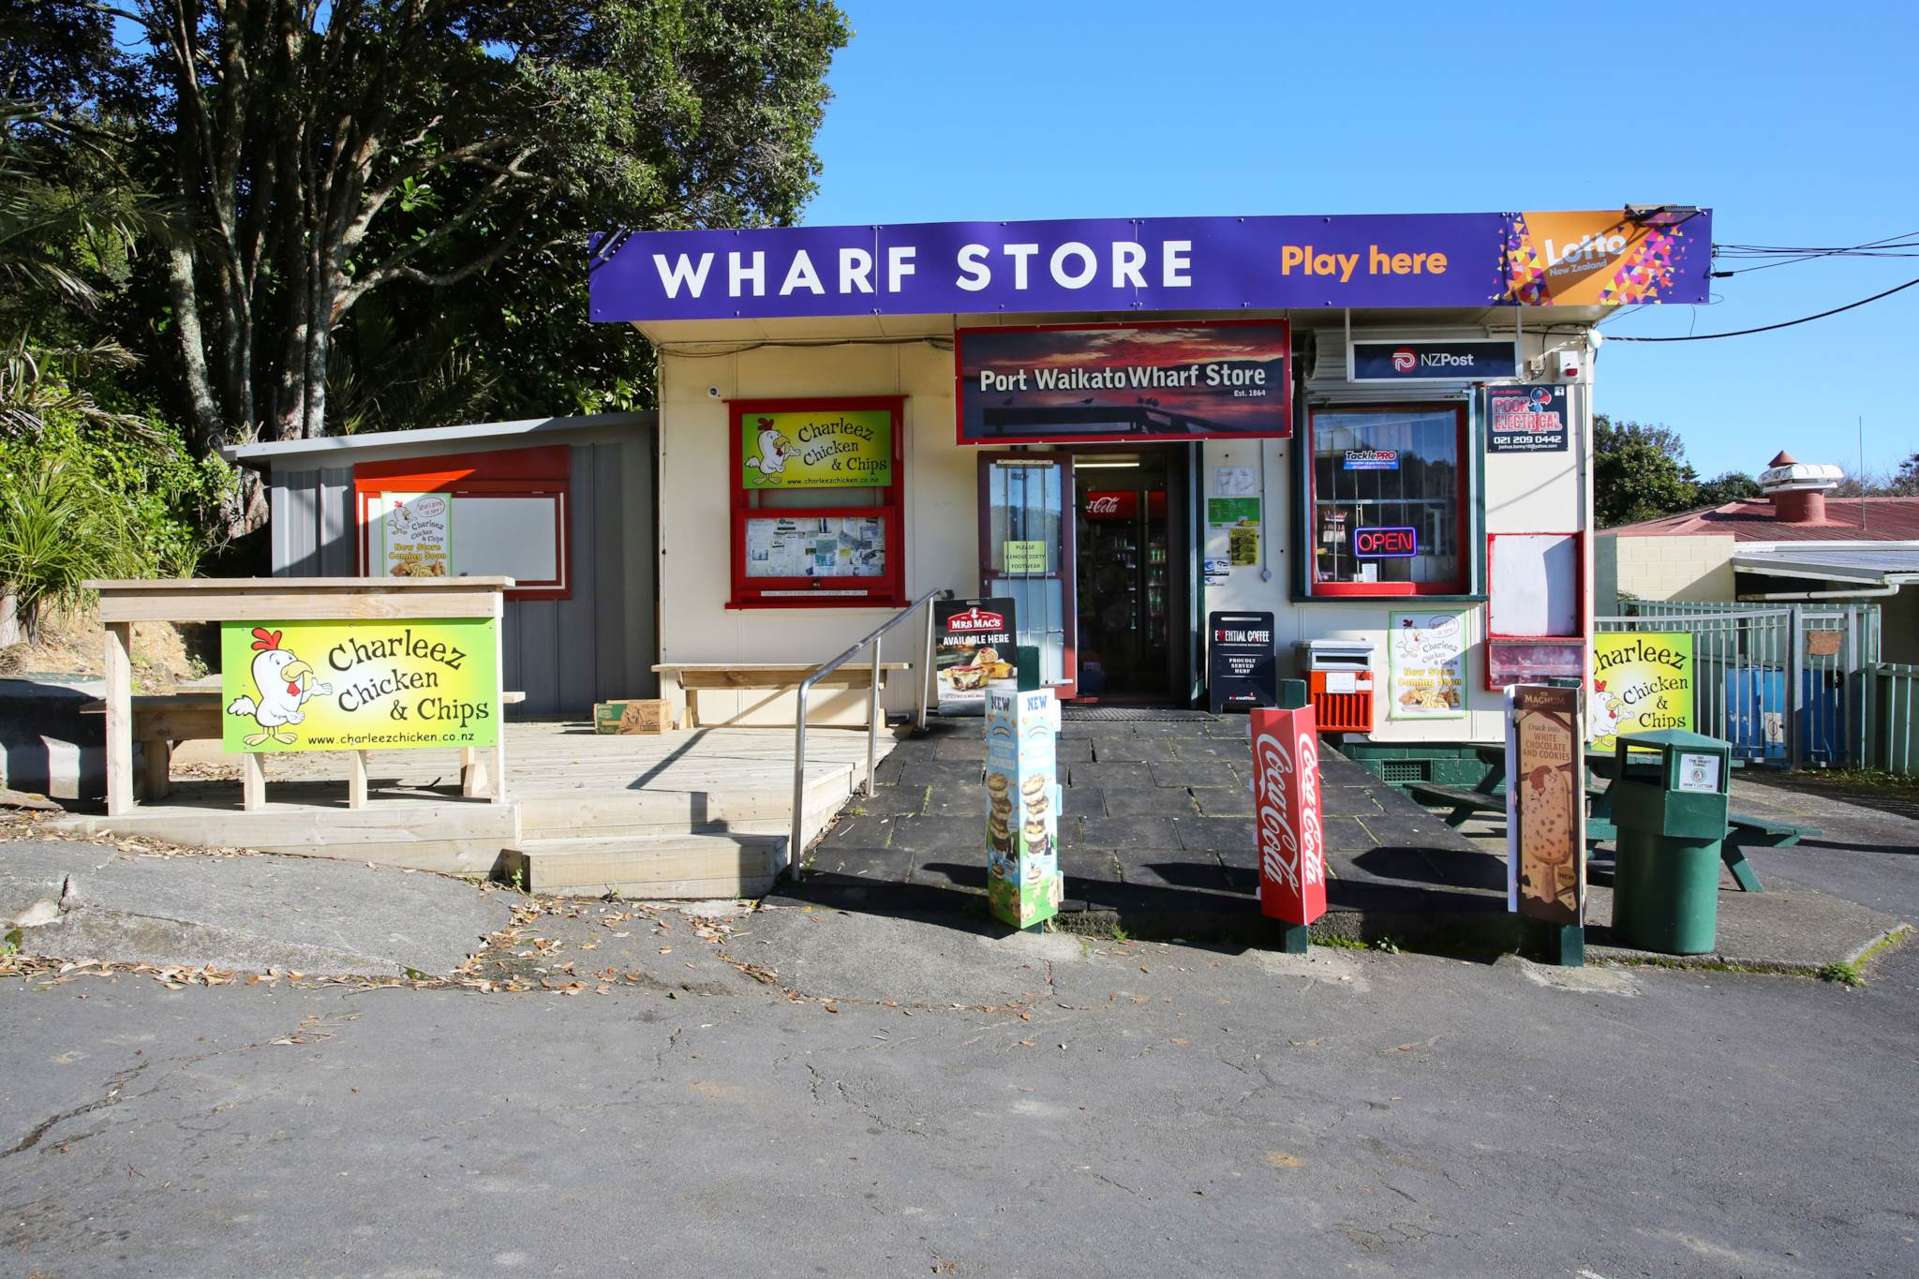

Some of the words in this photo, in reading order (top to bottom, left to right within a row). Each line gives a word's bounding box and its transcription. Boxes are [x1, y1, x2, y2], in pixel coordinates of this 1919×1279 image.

[1544, 232, 1627, 267] Lotto
[653, 246, 916, 299] WHARF
[956, 240, 1192, 292] STORE
[1281, 245, 1359, 283] Play
[1369, 244, 1448, 275] here
[1550, 267, 1570, 277] New
[1570, 259, 1608, 273] Zealand
[1421, 353, 1474, 367] NZPost
[980, 368, 1027, 392] Port
[1034, 366, 1126, 391] Waikato
[1127, 364, 1199, 389] Wharf
[1206, 363, 1266, 386] Store
[798, 417, 875, 443] Charleez
[1494, 413, 1561, 431] ELECTRICAL
[1493, 436, 1511, 445] 021
[1513, 435, 1533, 444] 209
[1535, 435, 1562, 443] 0442
[803, 440, 859, 466] Chicken
[831, 458, 842, 471] &
[846, 457, 888, 475] Chips
[952, 620, 972, 630] MRS
[943, 634, 986, 646] AVAILABLE
[987, 634, 1010, 643] HERE
[328, 629, 467, 671] Charleez
[338, 668, 438, 712] Chicken
[1623, 675, 1688, 705] Chicken
[991, 695, 1010, 712] NEW
[1027, 694, 1047, 711] NEW
[1524, 694, 1566, 705] MAGNUM
[1656, 695, 1669, 710] &
[390, 699, 408, 721] &
[417, 697, 489, 728] Chips
[1639, 712, 1686, 729] Chips
[1525, 739, 1567, 752] CHOCOLATE
[1534, 732, 1557, 742] WHITE
[1539, 750, 1569, 761] COOKIES
